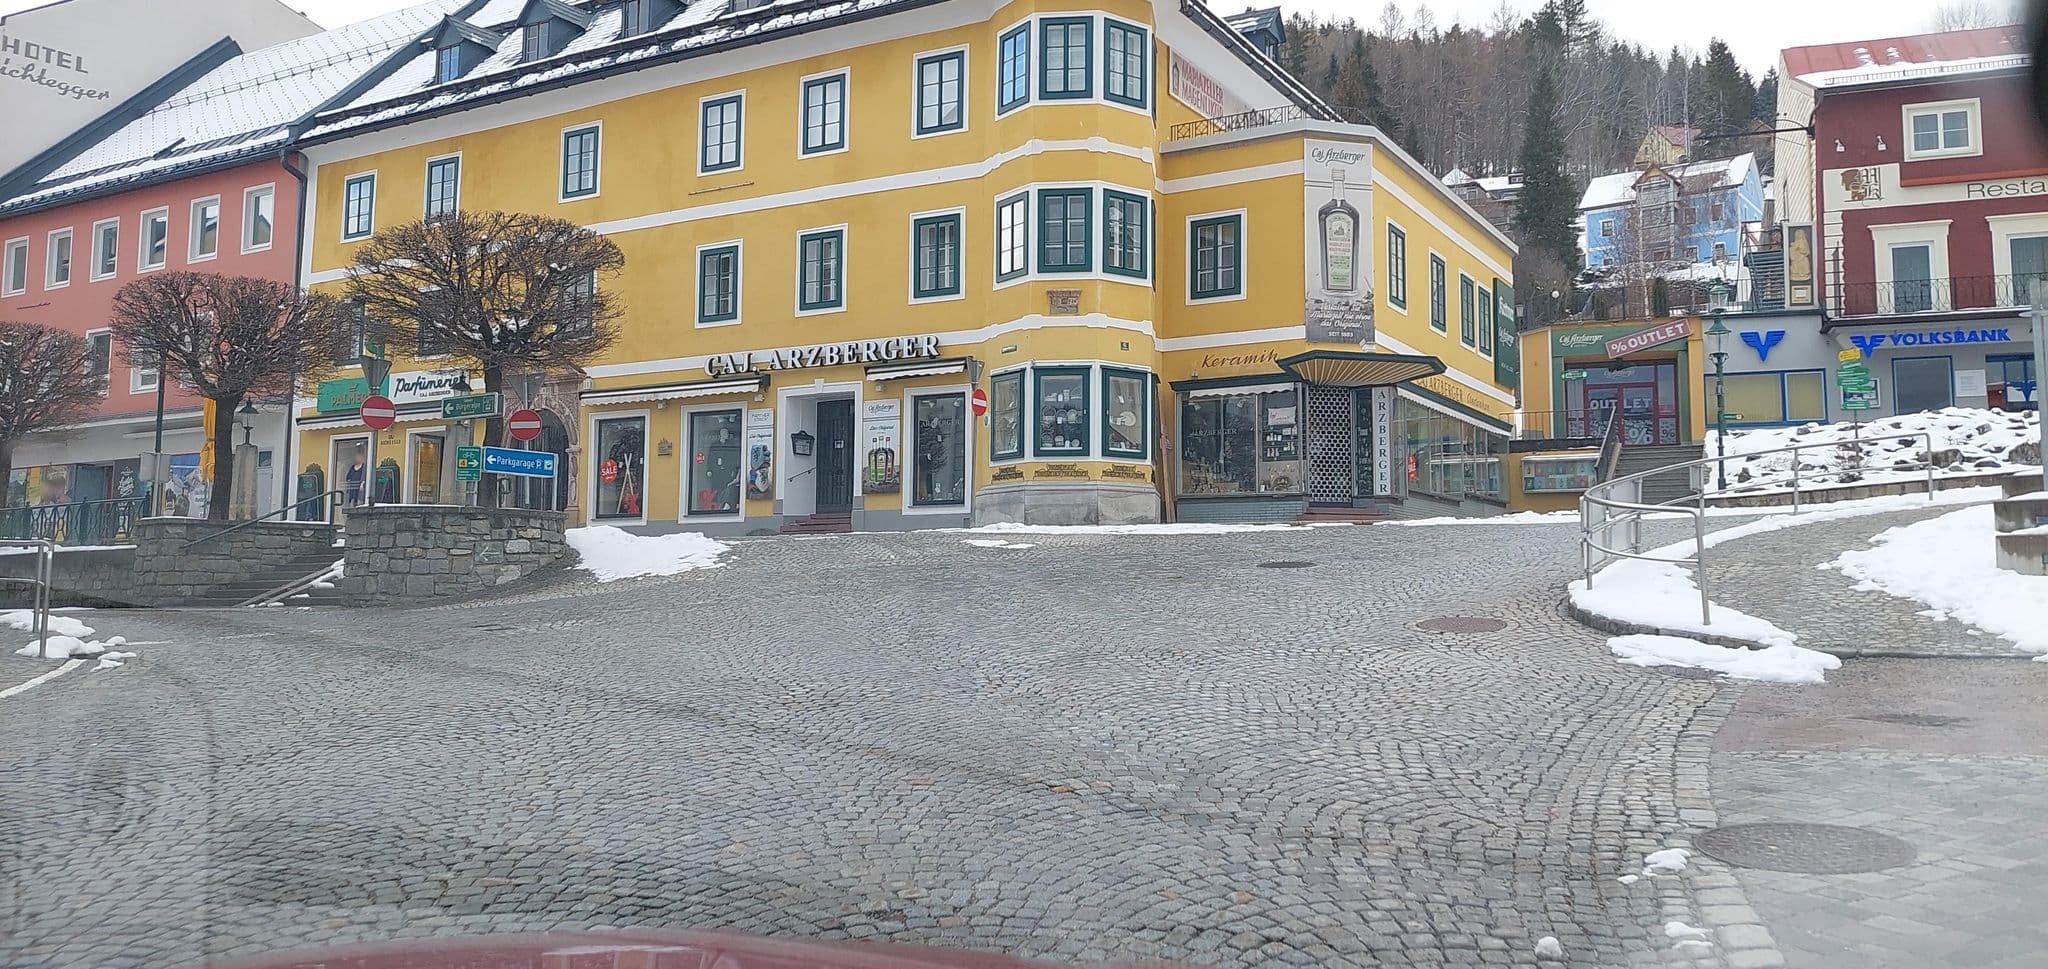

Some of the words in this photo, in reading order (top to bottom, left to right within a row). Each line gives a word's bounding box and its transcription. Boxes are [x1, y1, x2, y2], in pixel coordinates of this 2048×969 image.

[2, 35, 89, 74] HOTEL
[1325, 148, 1366, 166] Arzberger
[1627, 323, 1685, 349] OUTLET
[1889, 328, 2011, 346] VOLKSBANK
[704, 352, 759, 377] CAJ.
[767, 334, 940, 371] ARZBERGER
[1201, 348, 1278, 369] Keramik
[1623, 398, 1651, 409] LET
[1378, 391, 1388, 493] ARZBERGER
[496, 456, 535, 469] Parkgarage
[601, 466, 618, 476] SALE
